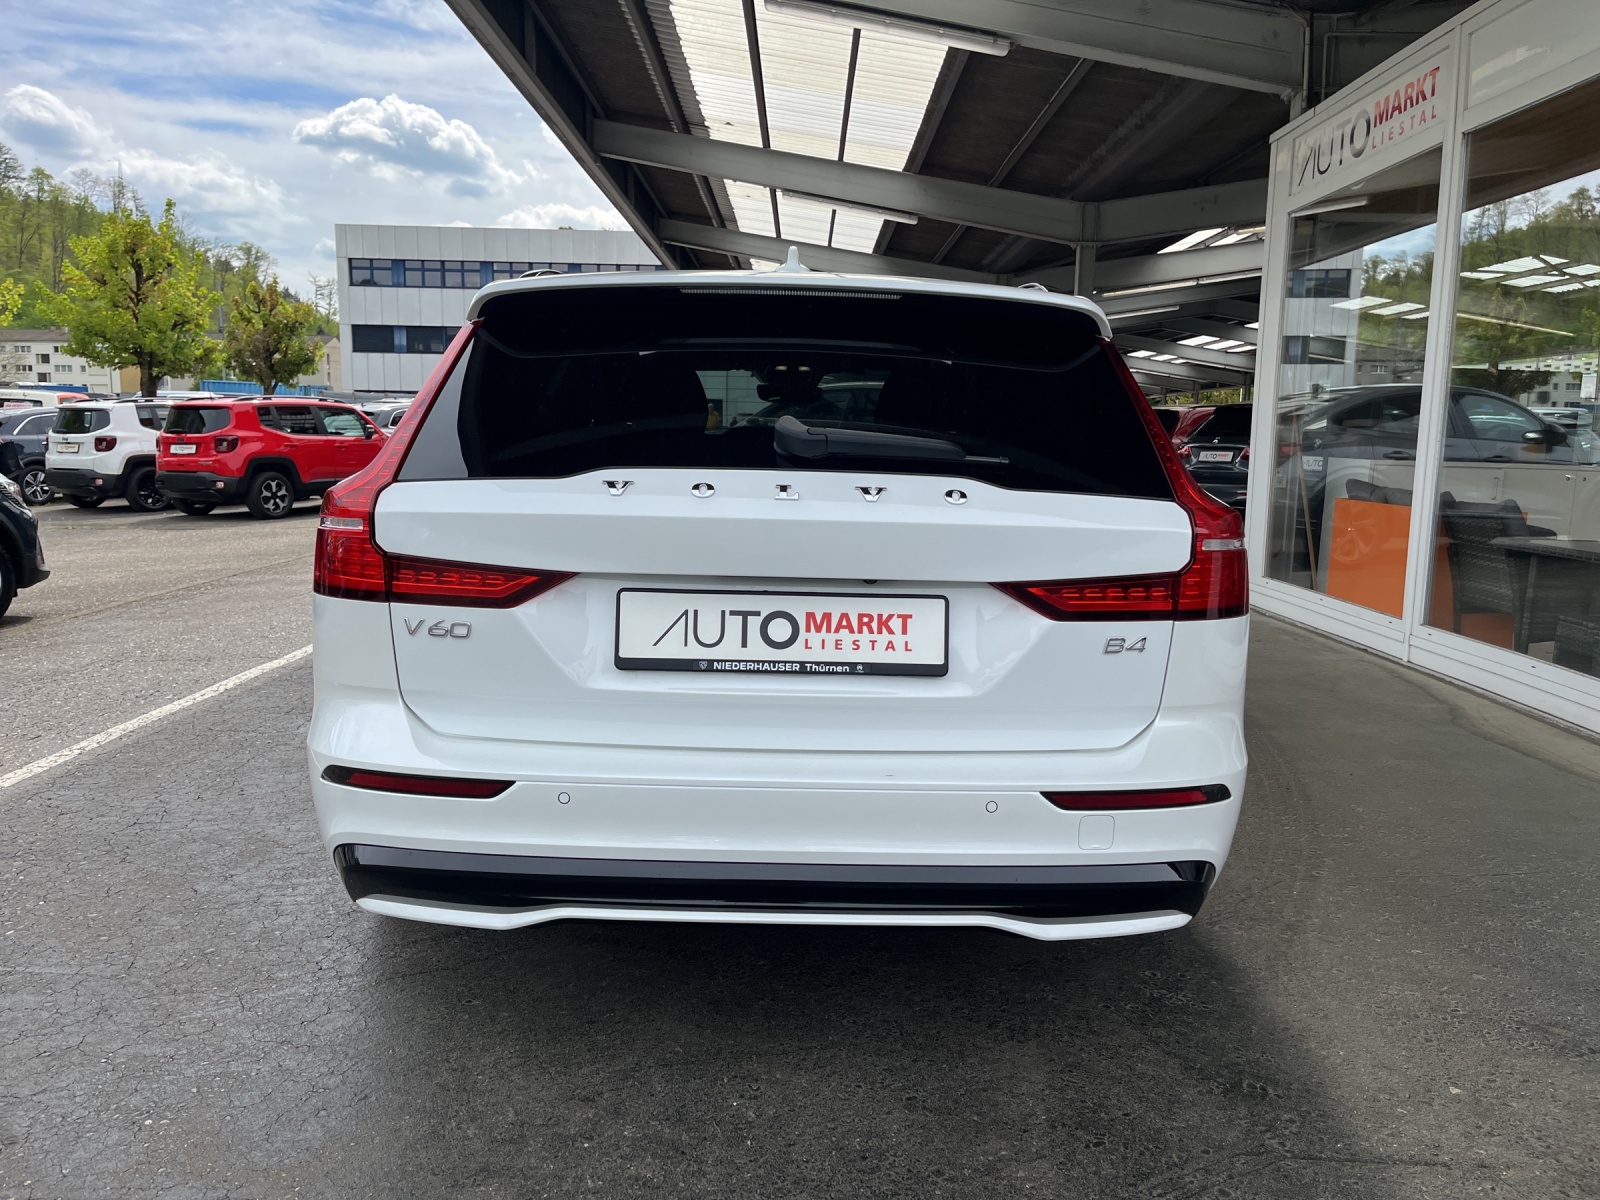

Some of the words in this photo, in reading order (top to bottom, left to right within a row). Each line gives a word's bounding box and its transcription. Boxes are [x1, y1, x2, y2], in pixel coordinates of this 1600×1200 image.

[1373, 66, 1441, 128] MARKT
[1371, 104, 1438, 150] LIESTAL
[1298, 108, 1371, 187] AUTO
[602, 480, 968, 505] VOLVO
[404, 617, 472, 639] V60
[652, 608, 801, 650] AUTO
[804, 611, 913, 636] MARKT
[804, 638, 913, 652] LIESTAL
[1102, 636, 1147, 654] B4
[713, 661, 800, 672] NIEDERHAUSER
[804, 663, 850, 672] Thürnen
